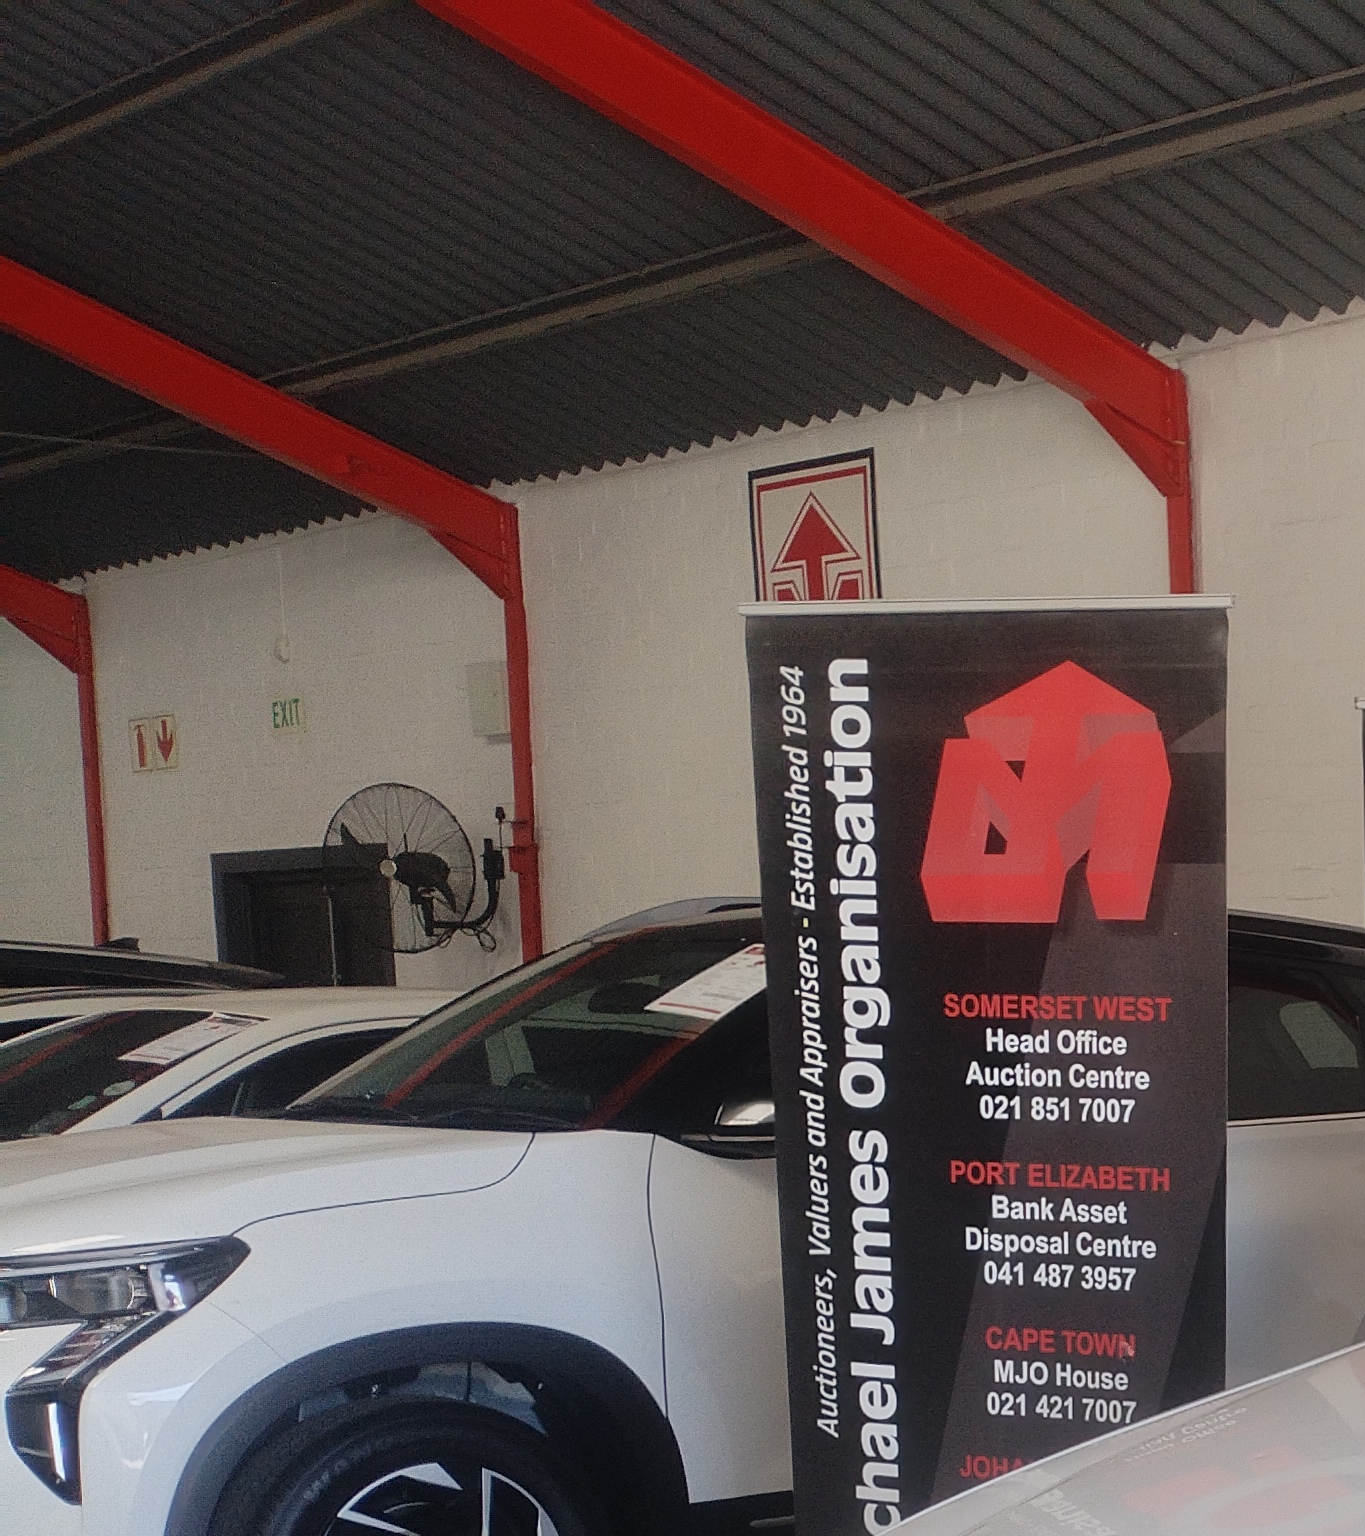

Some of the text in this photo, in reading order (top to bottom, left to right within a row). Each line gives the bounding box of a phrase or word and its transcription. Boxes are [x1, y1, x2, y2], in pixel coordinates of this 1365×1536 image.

[272, 698, 300, 729] EXIT
[780, 665, 806, 737] 1964
[782, 743, 816, 912] Established
[823, 657, 891, 1109] Organisation
[796, 935, 828, 1087] Appraisers
[943, 992, 1172, 1022] SOMERSET WEST
[985, 1027, 1128, 1056] Head Office
[965, 1061, 1150, 1090] Auction Centre
[804, 1090, 827, 1146] and
[979, 1096, 1136, 1123] 021 851 7007
[949, 1160, 1171, 1193] PORT ELIZABETH
[805, 1154, 830, 1257] Valuers
[991, 1195, 1127, 1224] Bank Asset
[849, 1129, 895, 1345] James
[965, 1227, 1157, 1258] Disposal Centre
[983, 1261, 1137, 1291] 041 487 3957
[814, 1268, 841, 1438] Auctioneers,
[985, 1326, 1136, 1359] CAPE TOWN
[993, 1360, 1129, 1391] MJO House
[986, 1391, 1137, 1423] 021 421 7007
